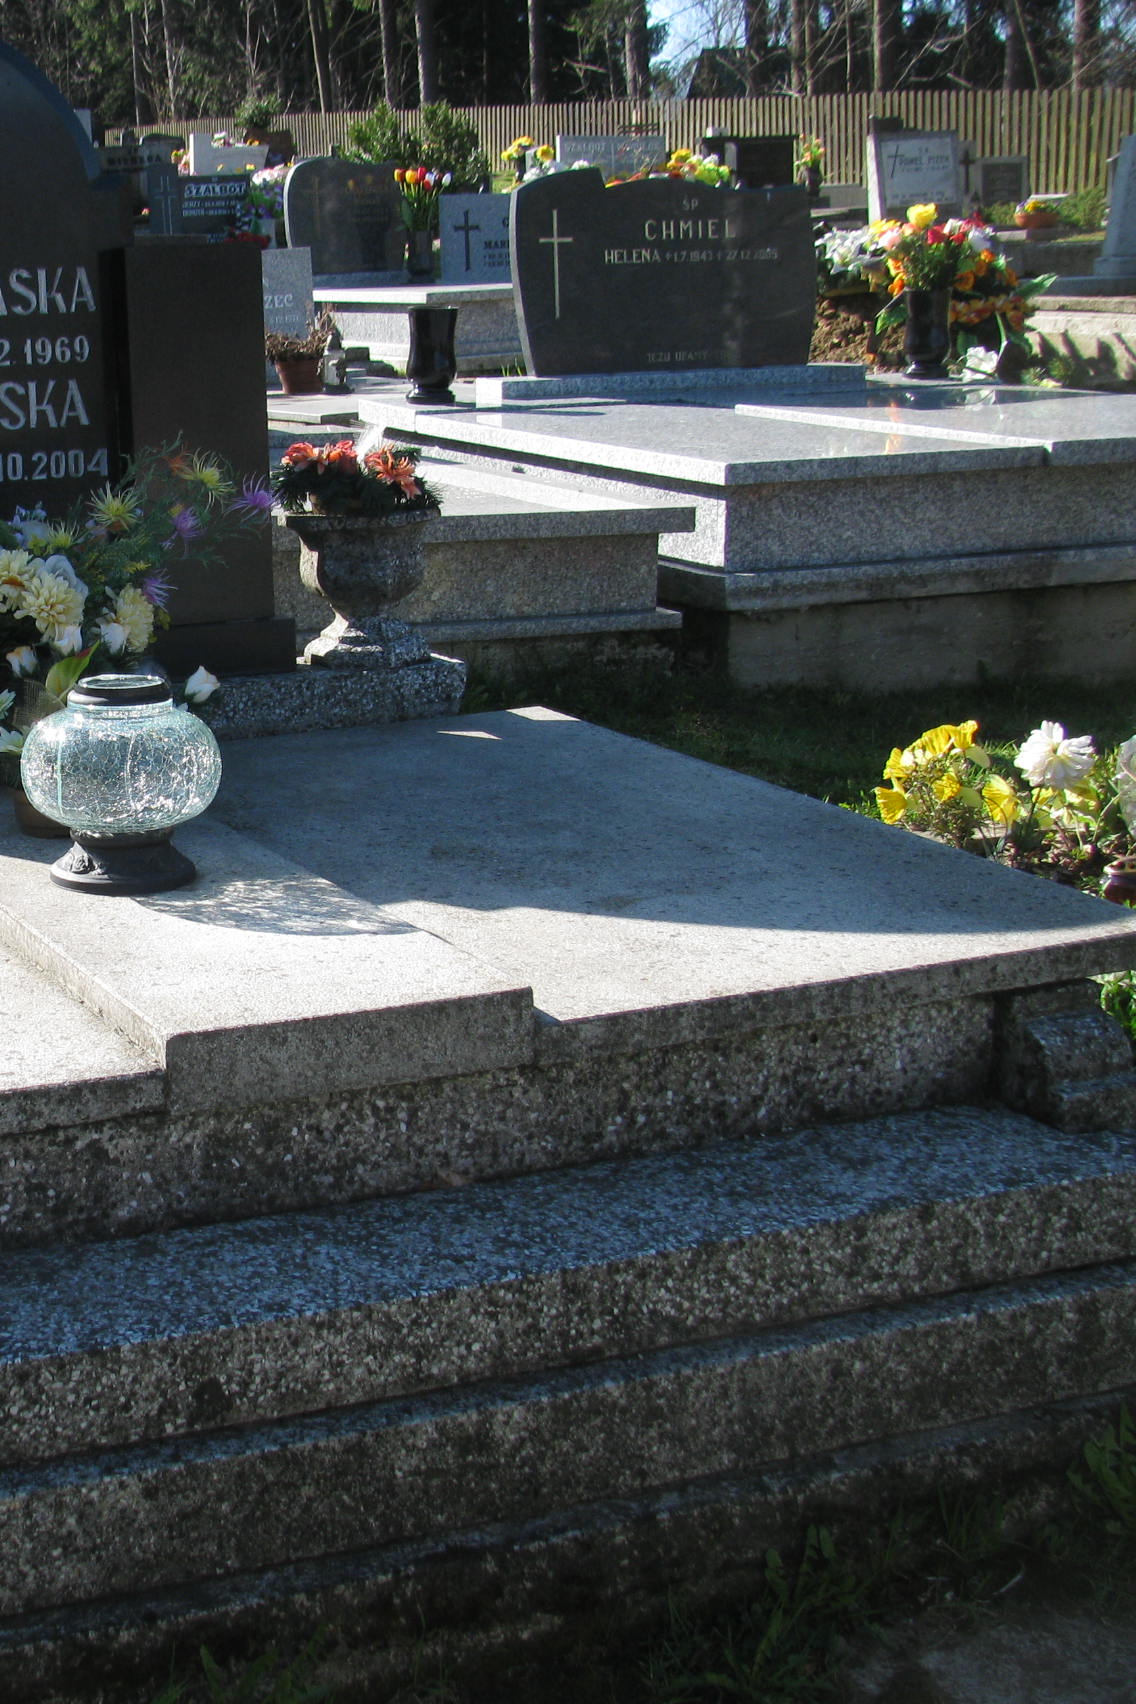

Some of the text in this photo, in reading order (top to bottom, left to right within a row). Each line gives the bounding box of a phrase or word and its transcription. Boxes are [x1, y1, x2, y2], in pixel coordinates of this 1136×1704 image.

[644, 218, 737, 241] CHMIEL
[604, 249, 661, 265] HELENA
[264, 294, 294, 310] ZEC
